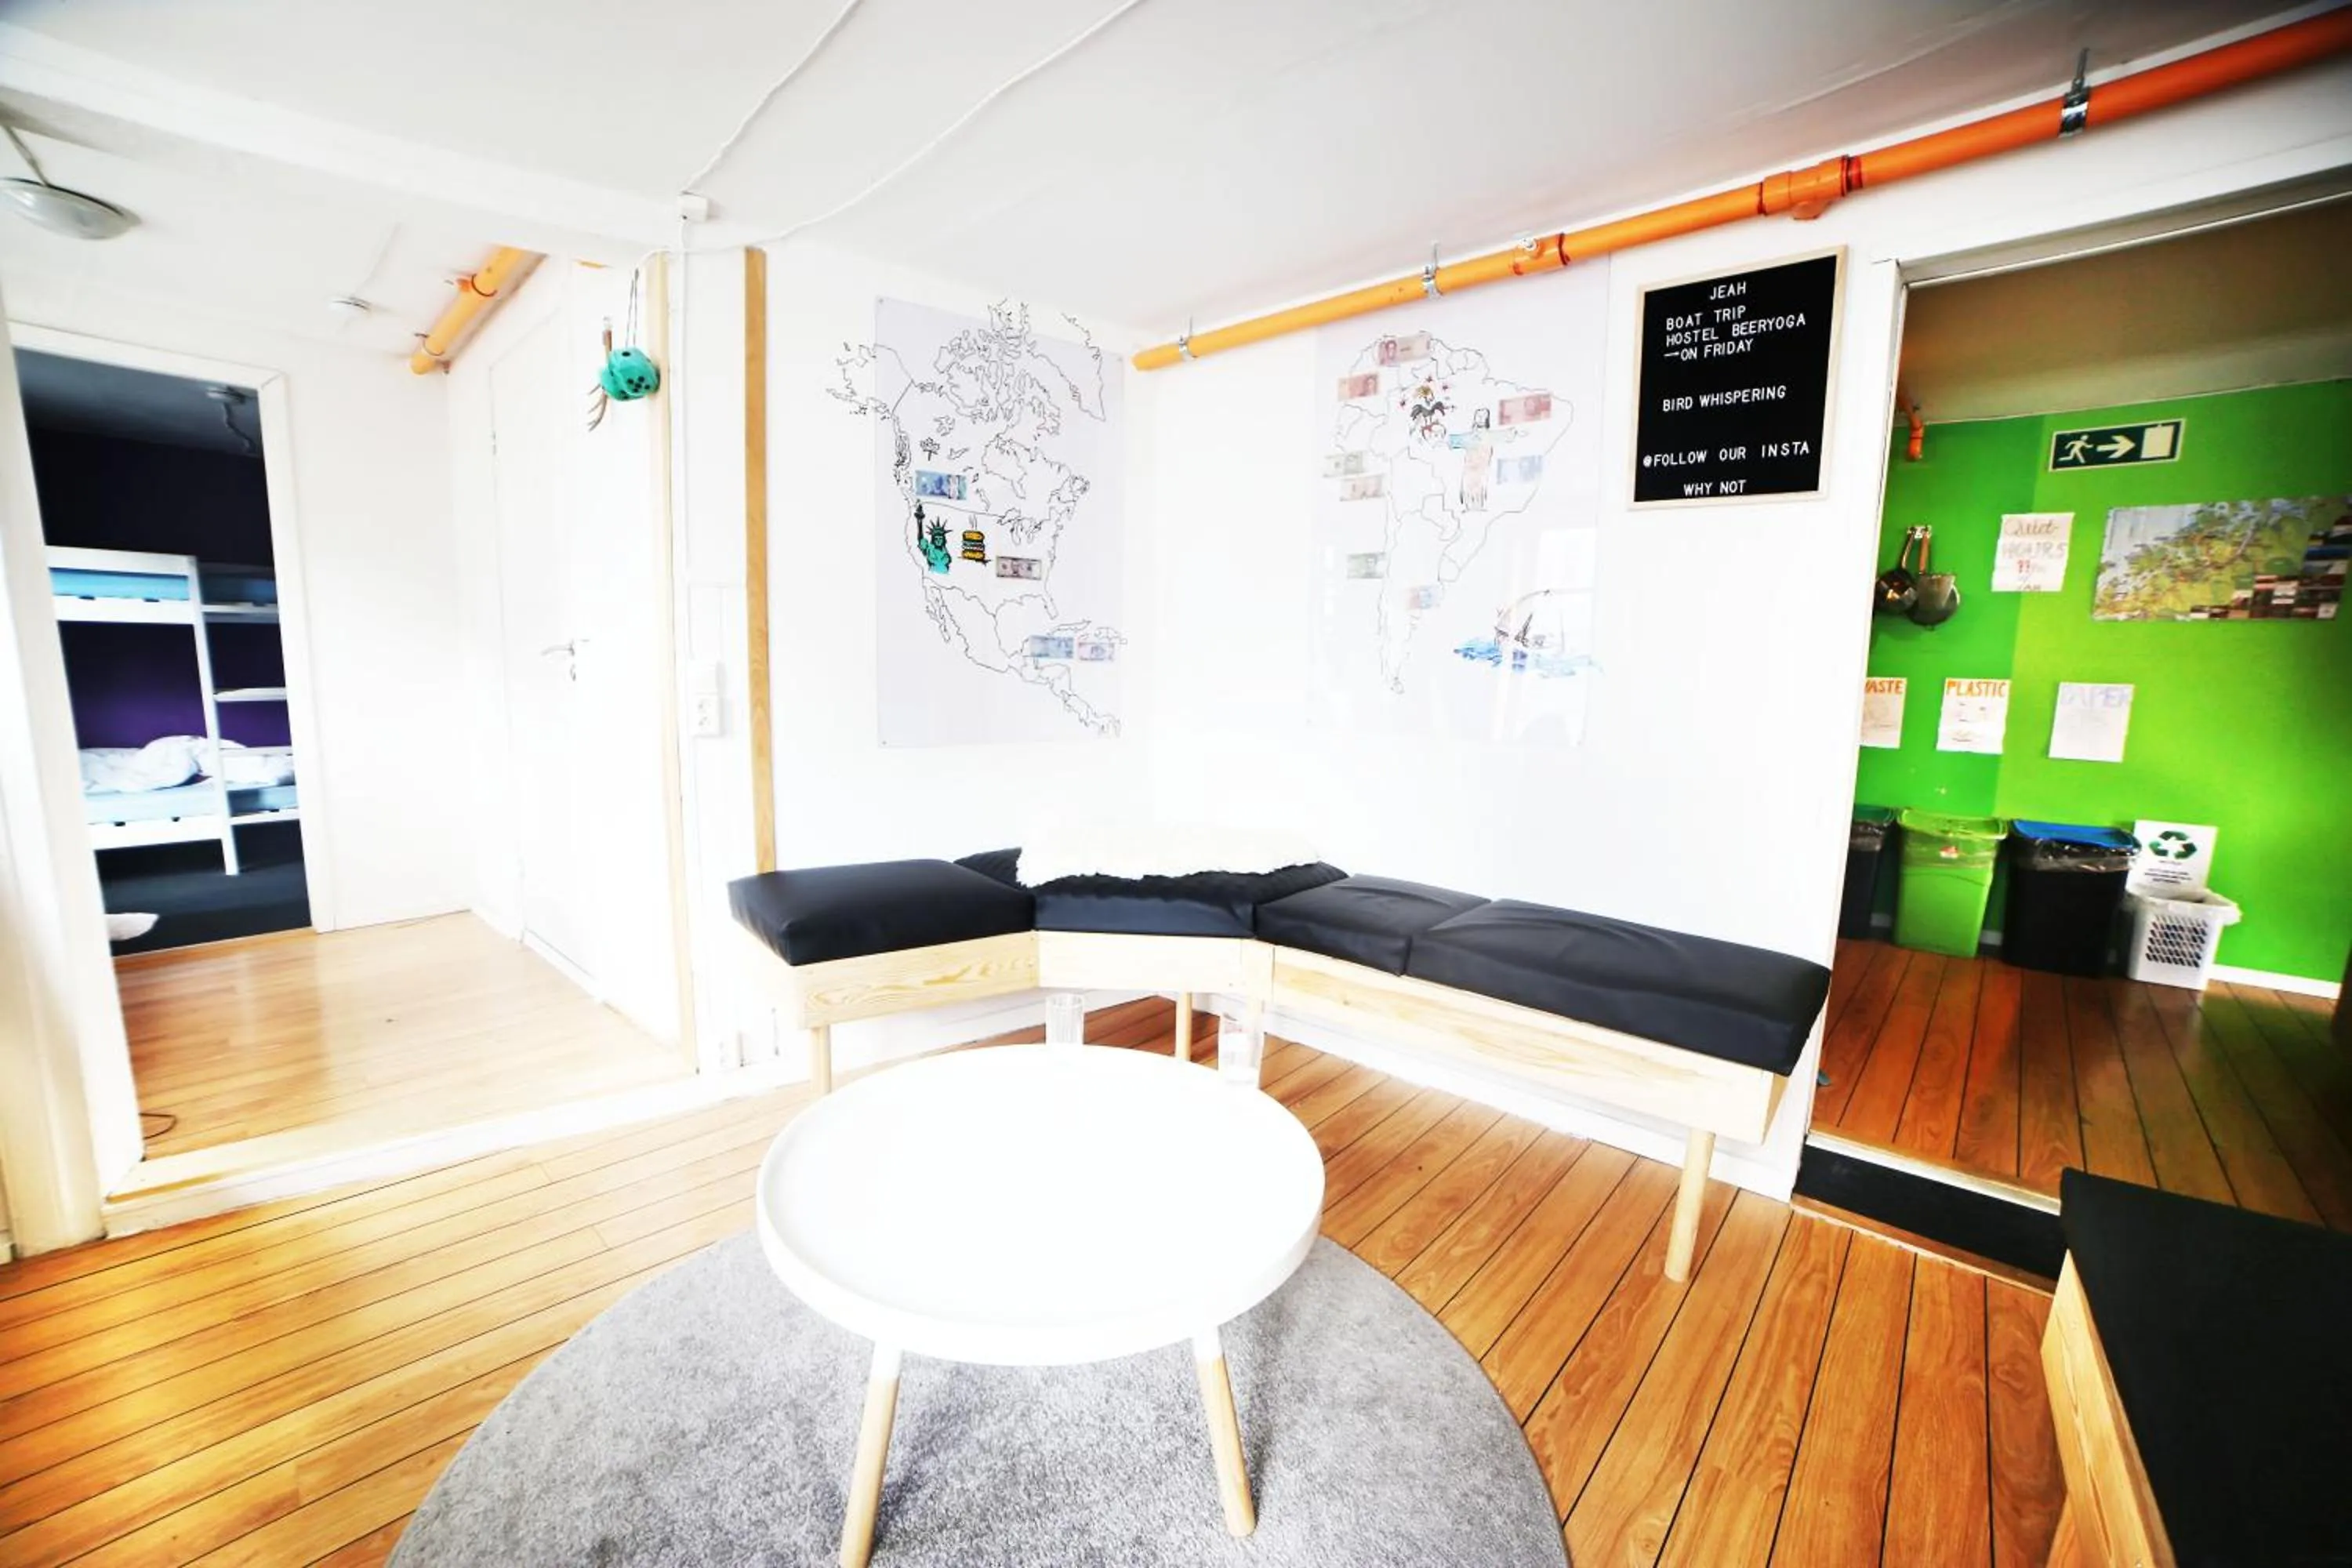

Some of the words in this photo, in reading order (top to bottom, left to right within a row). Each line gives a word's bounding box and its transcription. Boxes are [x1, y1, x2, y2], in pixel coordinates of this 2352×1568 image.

[1710, 281, 1747, 300] JEAH
[1666, 312, 1703, 331] BOAT
[1714, 305, 1746, 323] TRIP
[1666, 327, 1719, 347] HOSTEL
[1732, 313, 1806, 337] BEERYOGA
[1704, 338, 1754, 359] FRIDAY
[1663, 396, 1693, 412] BIRD
[1699, 385, 1787, 408] WHISPERING
[1719, 446, 1747, 462] OUR
[1762, 441, 1809, 458] INSTA
[1684, 481, 1712, 497] WHY
[1719, 479, 1747, 494] NOT
[1946, 681, 2007, 698] PLASTIC
